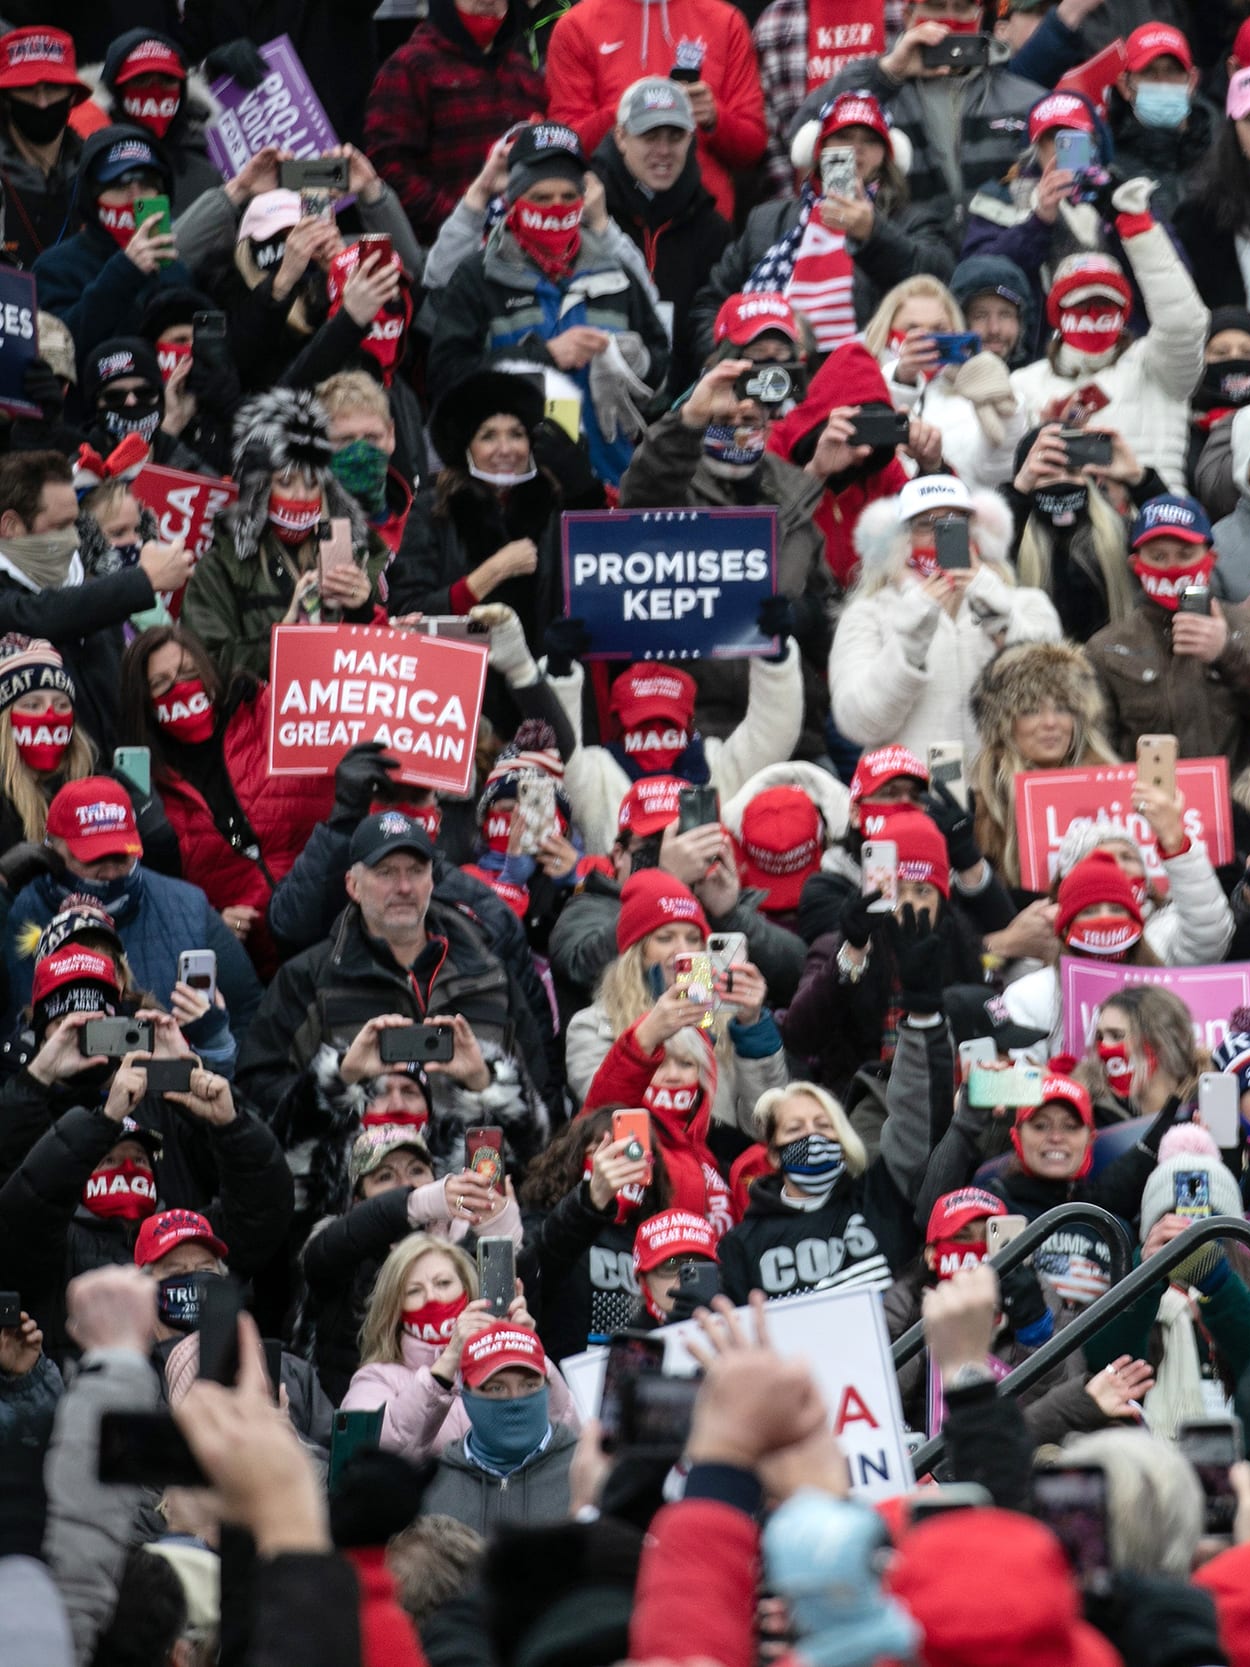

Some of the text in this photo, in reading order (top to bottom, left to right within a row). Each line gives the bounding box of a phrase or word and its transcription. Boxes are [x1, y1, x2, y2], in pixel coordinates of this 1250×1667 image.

[237, 90, 280, 152] VOIC
[256, 71, 321, 160] PRO-LI
[98, 205, 133, 228] MA
[257, 242, 286, 270] MA
[368, 318, 405, 341] AG
[574, 548, 769, 587] PROMISES
[623, 586, 721, 621] KEPT
[333, 648, 418, 682] MAKE
[158, 691, 210, 723] AG
[280, 679, 467, 731] AMERICA
[279, 721, 464, 763] GREAT AGAIN
[1083, 927, 1130, 946] TRUMP
[644, 1087, 698, 1110] AG
[641, 1212, 714, 1240] MAKE AMERICA
[649, 1227, 680, 1251] GREAT
[940, 1252, 989, 1274] MA
[167, 1287, 198, 1303] TRU
[404, 1317, 458, 1341] MAG
[468, 1330, 537, 1355] MAKE AMERICA
[474, 1341, 533, 1361] GREAT AGAIN
